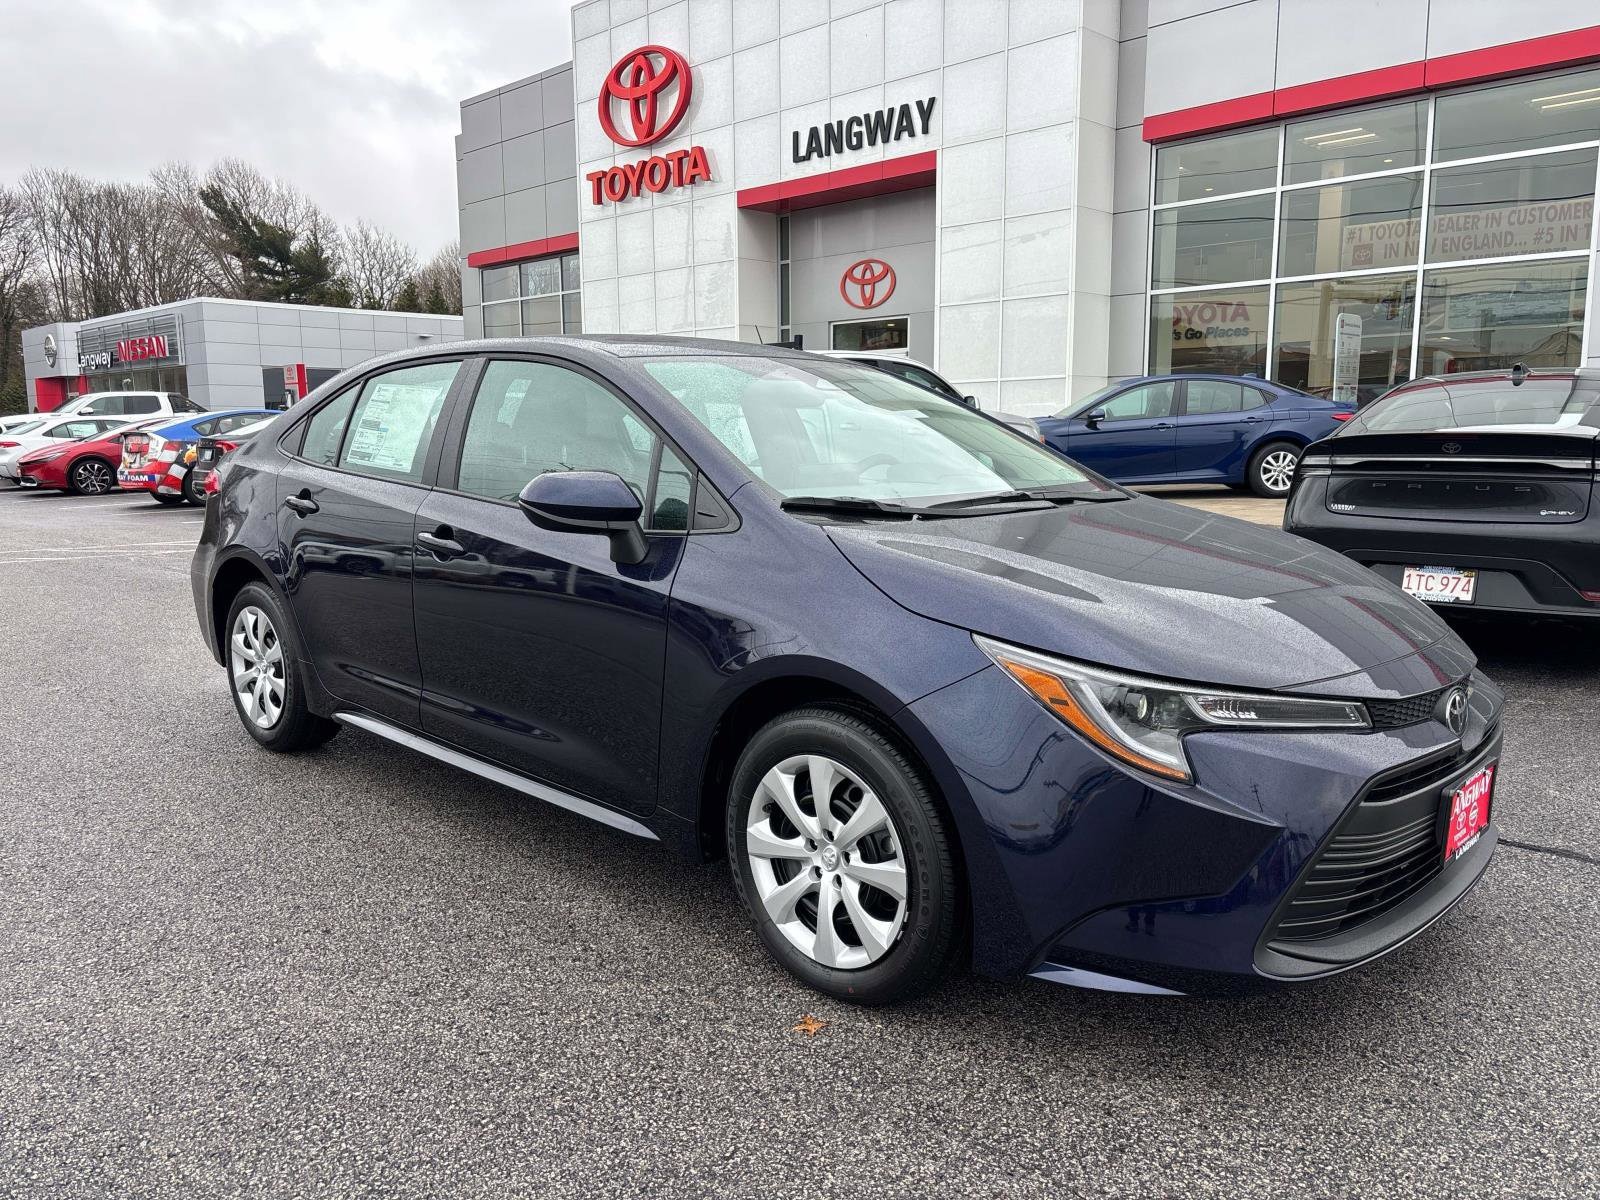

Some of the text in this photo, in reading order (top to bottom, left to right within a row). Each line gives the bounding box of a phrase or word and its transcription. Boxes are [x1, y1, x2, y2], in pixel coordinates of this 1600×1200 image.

[791, 96, 936, 164] LANGWAY
[586, 145, 712, 205] TOYOTA
[1346, 226, 1362, 245] #1
[1484, 212, 1503, 229] IN
[1507, 201, 1593, 226] CUSTOMER
[1383, 241, 1400, 259] IN
[1441, 230, 1528, 255] ENGLAND...
[1534, 226, 1554, 246] #5
[1560, 223, 1578, 243] IN
[1173, 301, 1250, 326] OYOTA
[1184, 327, 1203, 340] Go
[1205, 326, 1250, 339] Places
[77, 335, 169, 370] Langway NISSAN
[127, 474, 149, 482] FOAM
[1404, 573, 1472, 595] 1TC 974
